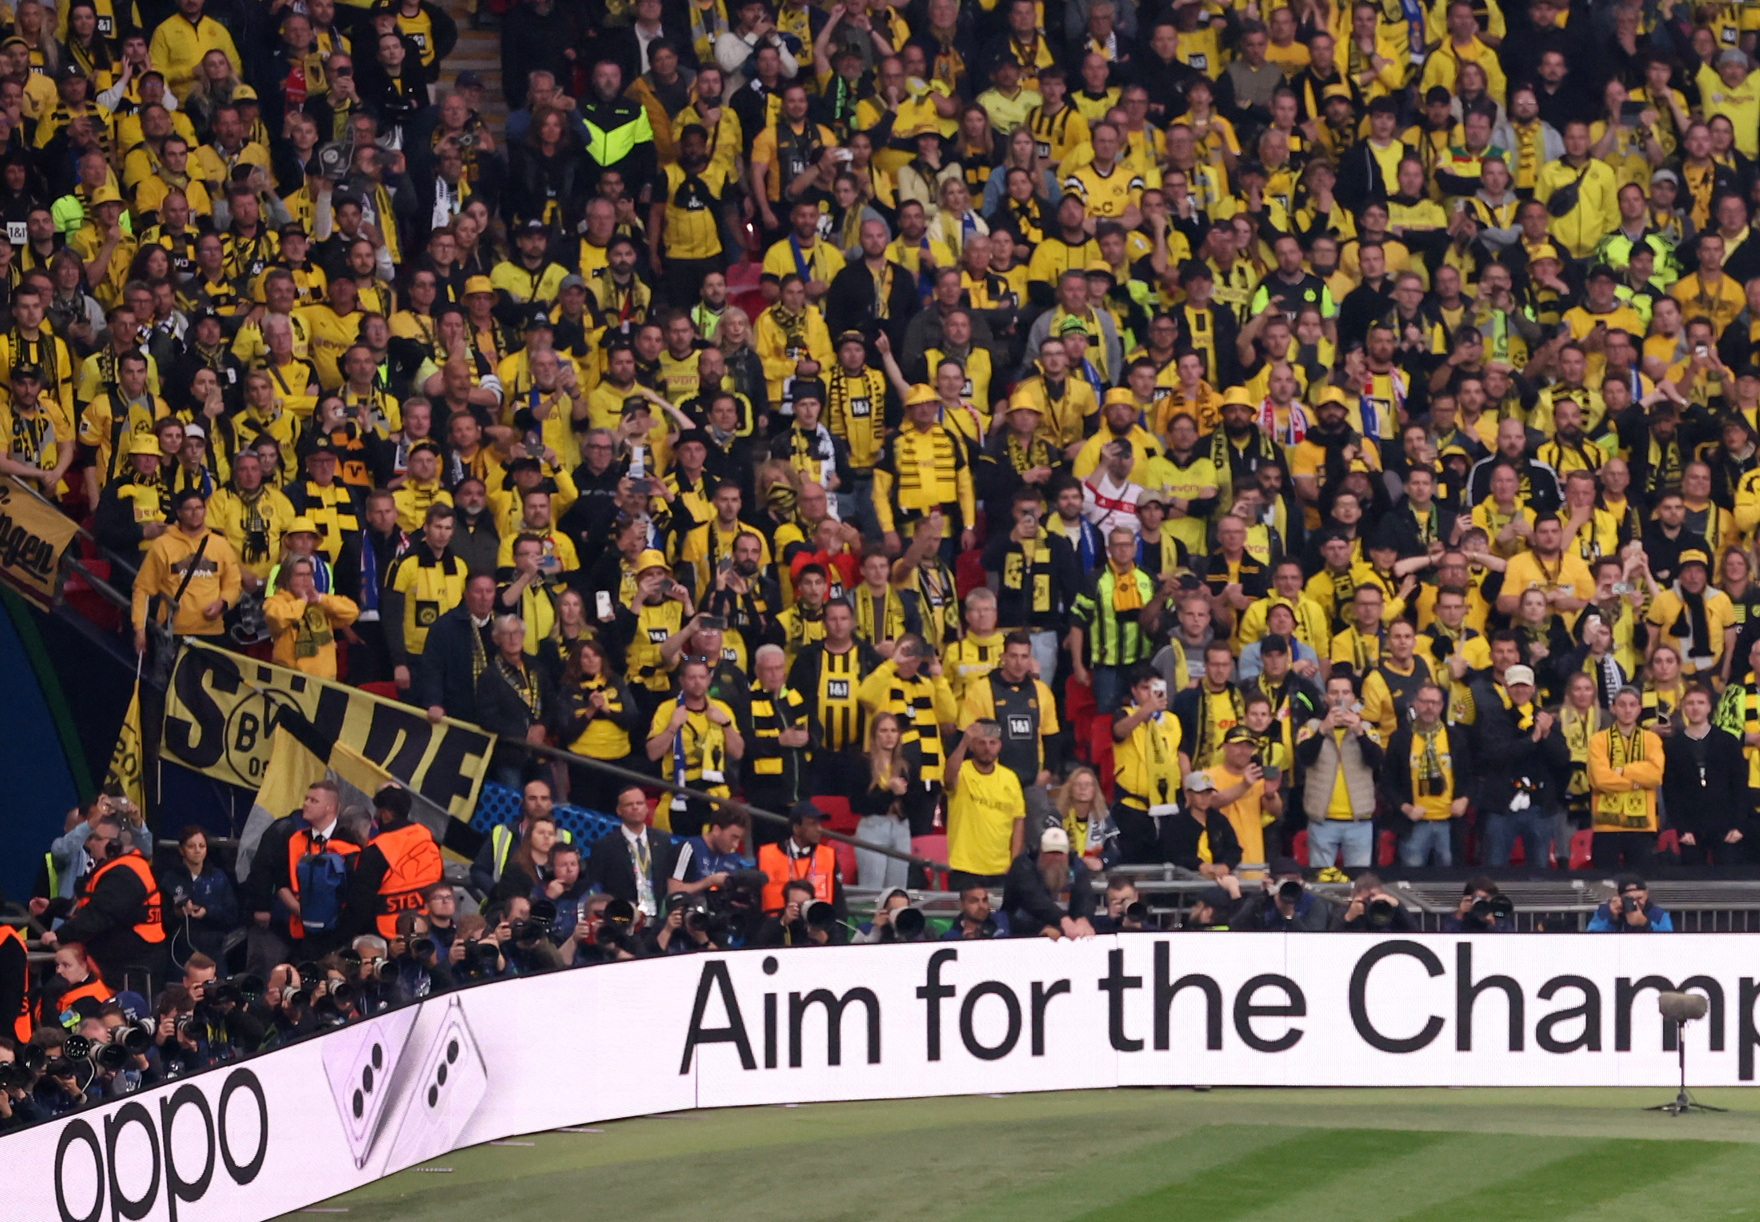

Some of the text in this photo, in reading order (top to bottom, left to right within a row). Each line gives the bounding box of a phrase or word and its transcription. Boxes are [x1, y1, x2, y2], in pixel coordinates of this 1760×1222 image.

[9, 227, 26, 241] 1&1
[827, 681, 849, 698] 1&1
[1008, 716, 1032, 737] 1&1
[679, 956, 881, 1075] Aim
[915, 948, 1071, 1062] for
[1098, 941, 1307, 1054] the
